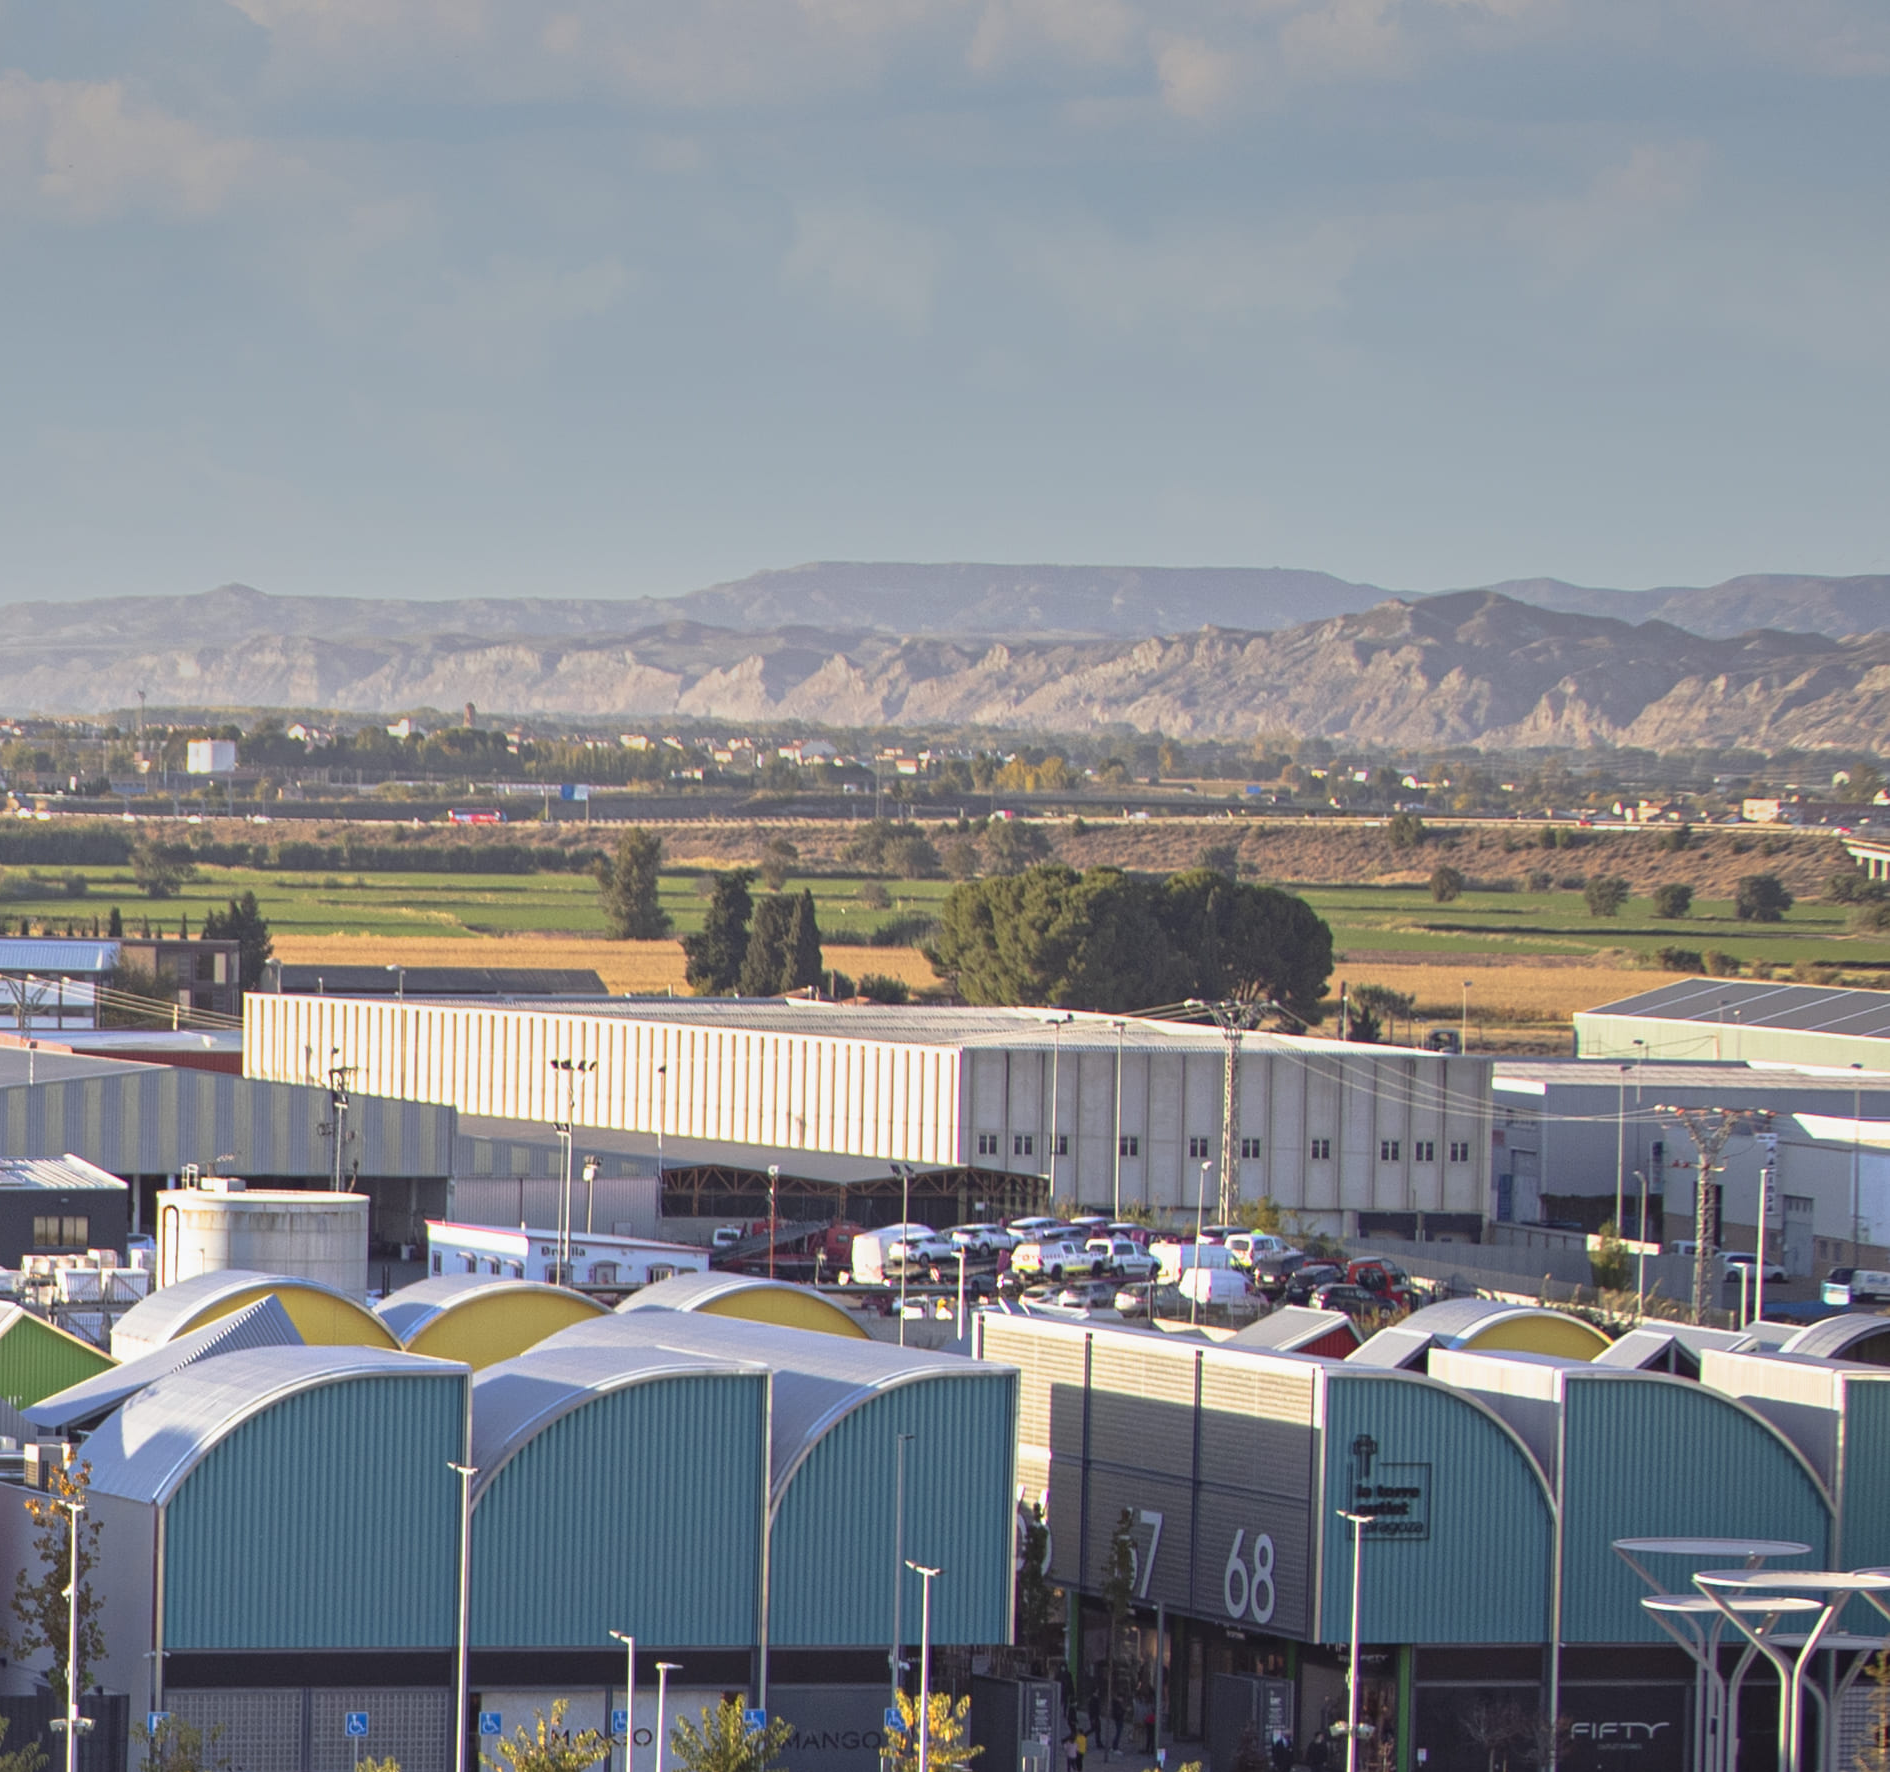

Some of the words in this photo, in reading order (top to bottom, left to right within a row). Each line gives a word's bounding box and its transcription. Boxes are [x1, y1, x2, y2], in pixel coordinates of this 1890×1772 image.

[1376, 1484, 1419, 1499] torre
[1358, 1521, 1424, 1536] aragoza
[1224, 1528, 1275, 1625] 68
[1571, 1722, 1670, 1739] FIFTY
[785, 1730, 882, 1750] MANGO
